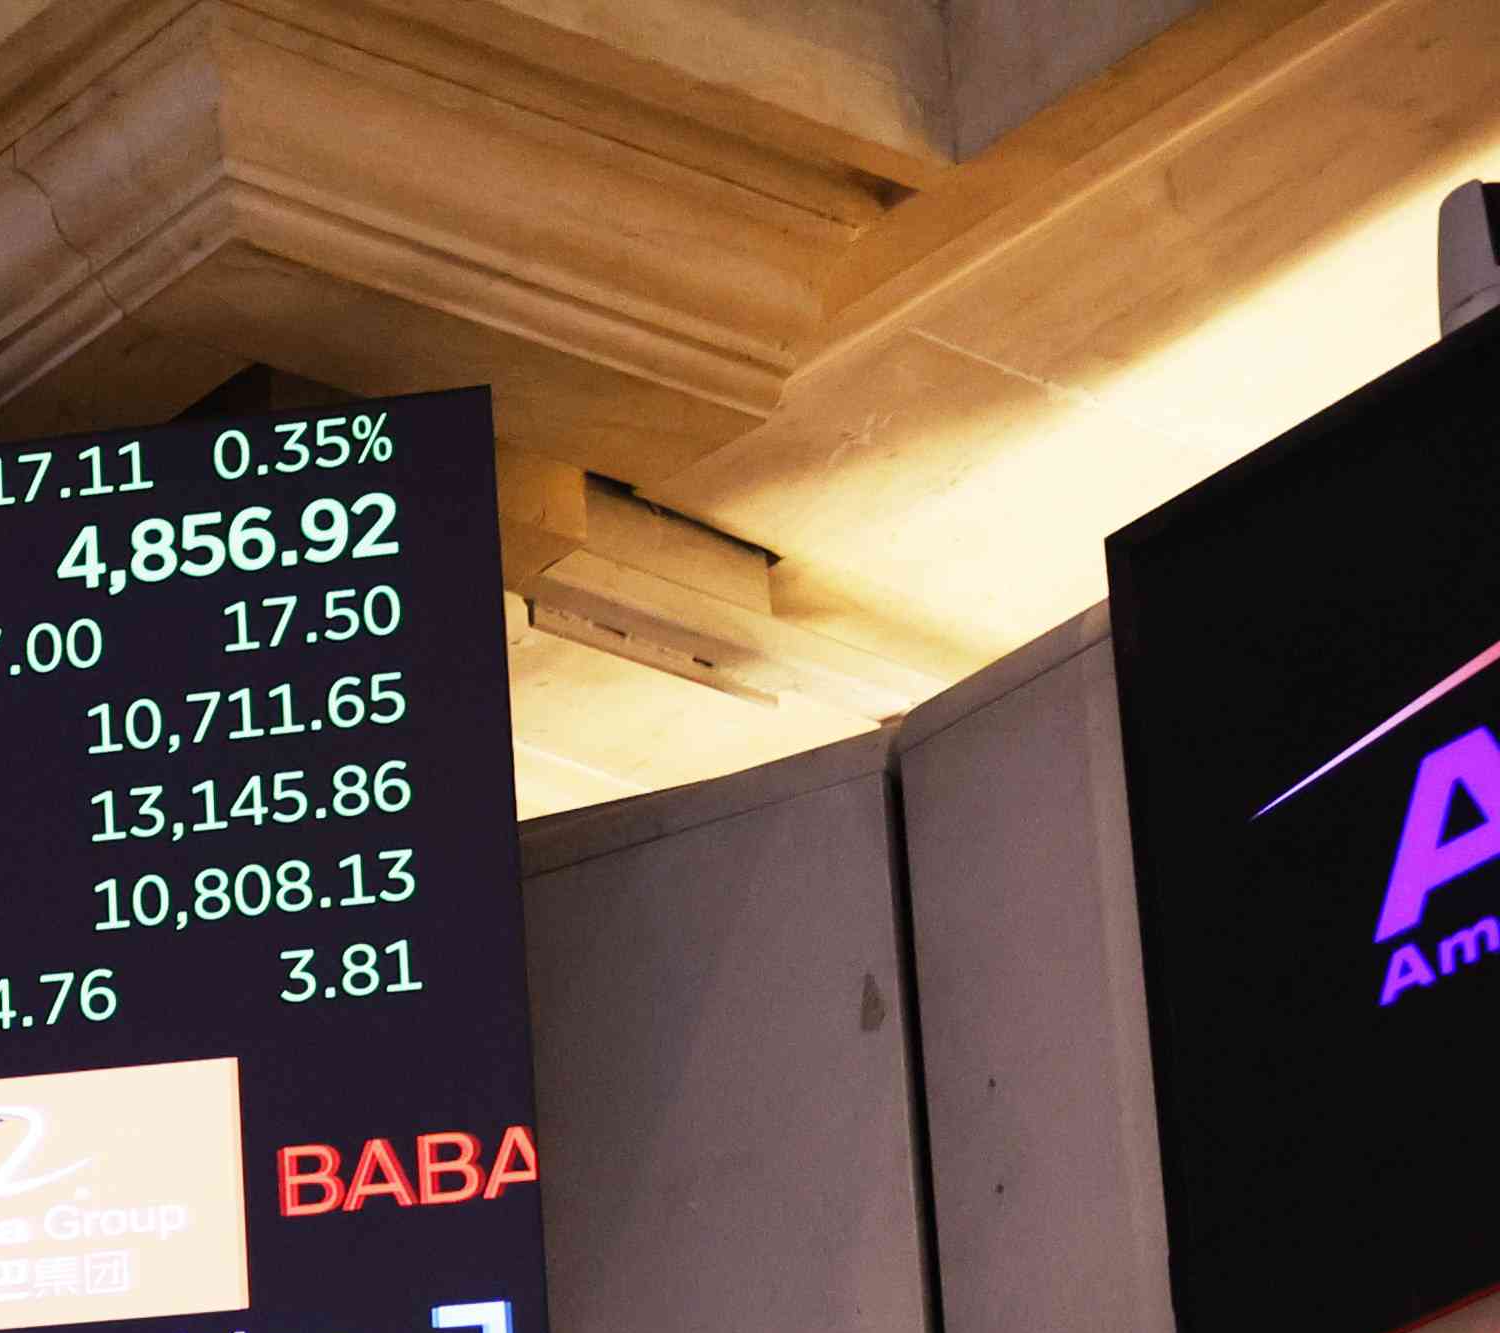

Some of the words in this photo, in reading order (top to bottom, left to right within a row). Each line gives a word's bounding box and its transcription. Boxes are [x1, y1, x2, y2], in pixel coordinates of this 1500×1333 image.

[214, 413, 392, 479] 0.35%
[57, 488, 399, 595] 4,856.92
[224, 585, 400, 652] 17.50
[88, 672, 405, 754] 10,711.65
[91, 760, 411, 842] 13,145.86
[95, 849, 415, 930] 10,808.13
[281, 940, 422, 1002] 3.81
[277, 1126, 540, 1217] BABA
[43, 1203, 190, 1240] Group
